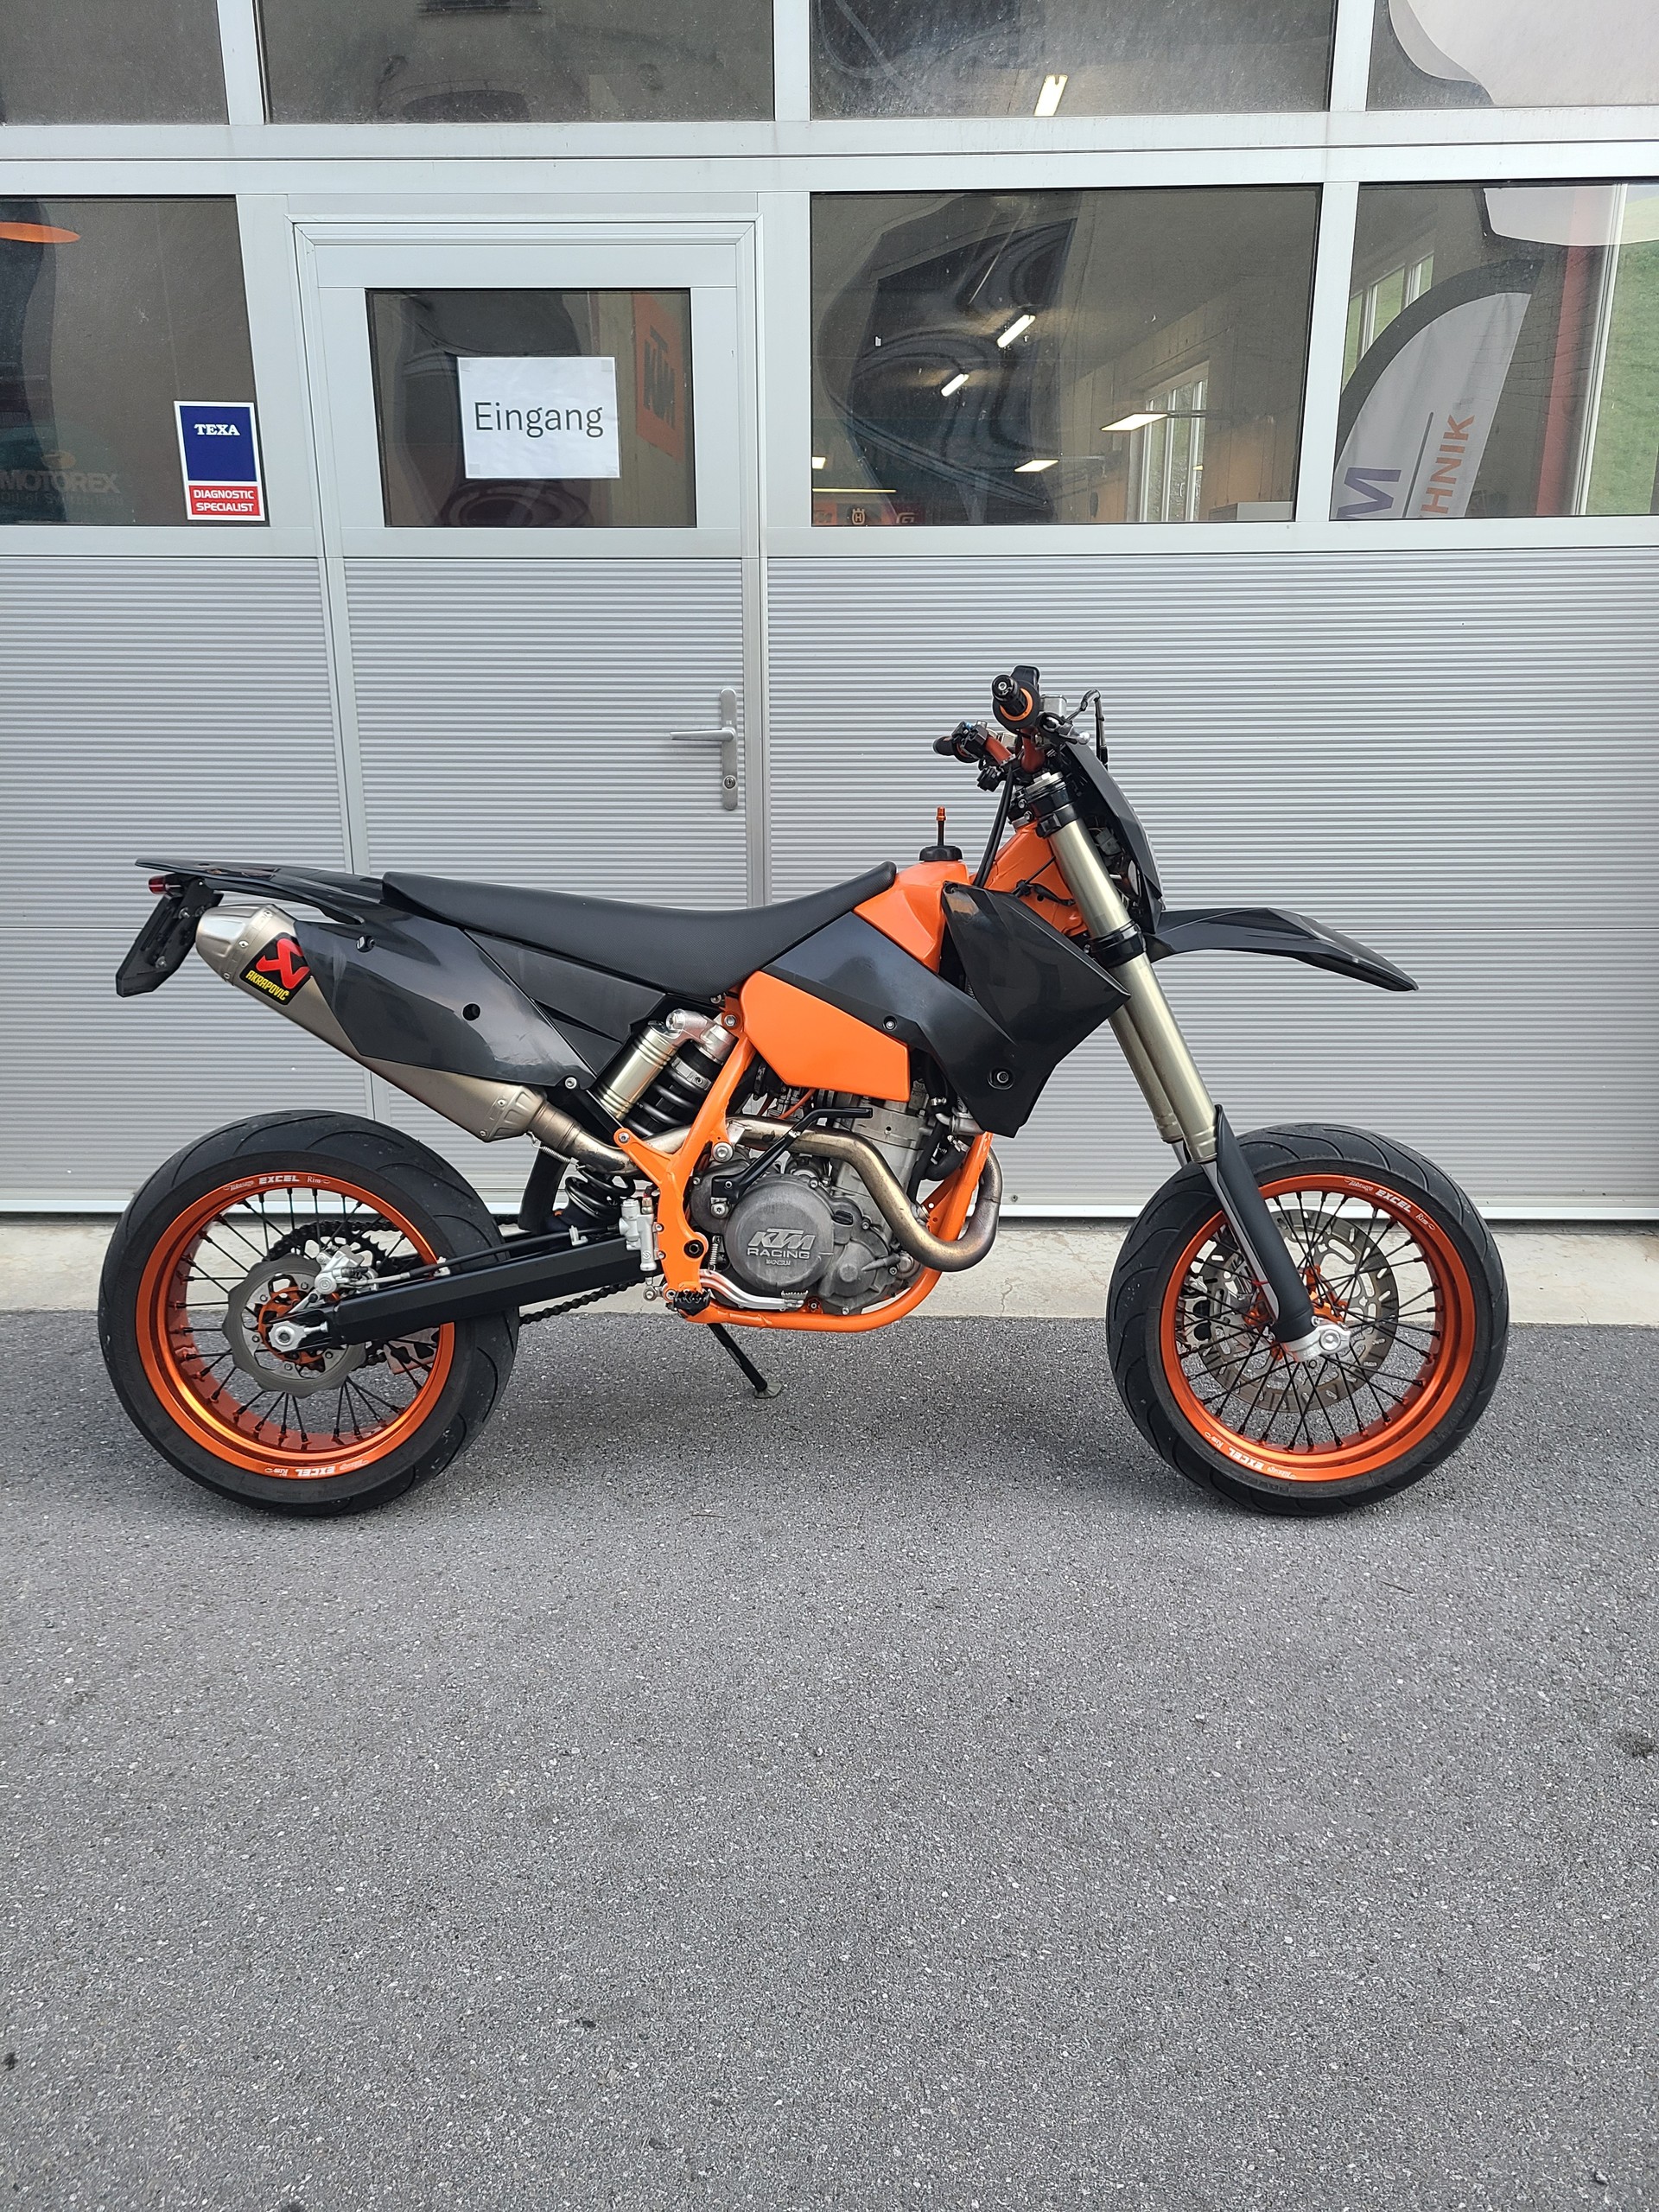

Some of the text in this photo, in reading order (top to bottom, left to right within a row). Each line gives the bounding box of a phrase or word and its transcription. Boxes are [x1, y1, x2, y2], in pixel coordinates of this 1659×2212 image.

[474, 401, 604, 438] Eingang
[194, 423, 240, 436] TEXA
[1419, 415, 1475, 518] HNIK
[0, 469, 121, 493] MOTOREX
[193, 489, 255, 499] DIAGNOSTIC
[196, 502, 254, 512] SPECIALIST
[258, 1174, 300, 1185] EXCEL
[1375, 1188, 1411, 1213] EXCEL
[748, 1228, 816, 1250] KTM
[747, 1247, 810, 1260] RACING
[1229, 1446, 1265, 1471] EXCEL
[295, 1465, 336, 1477] EXCEL
